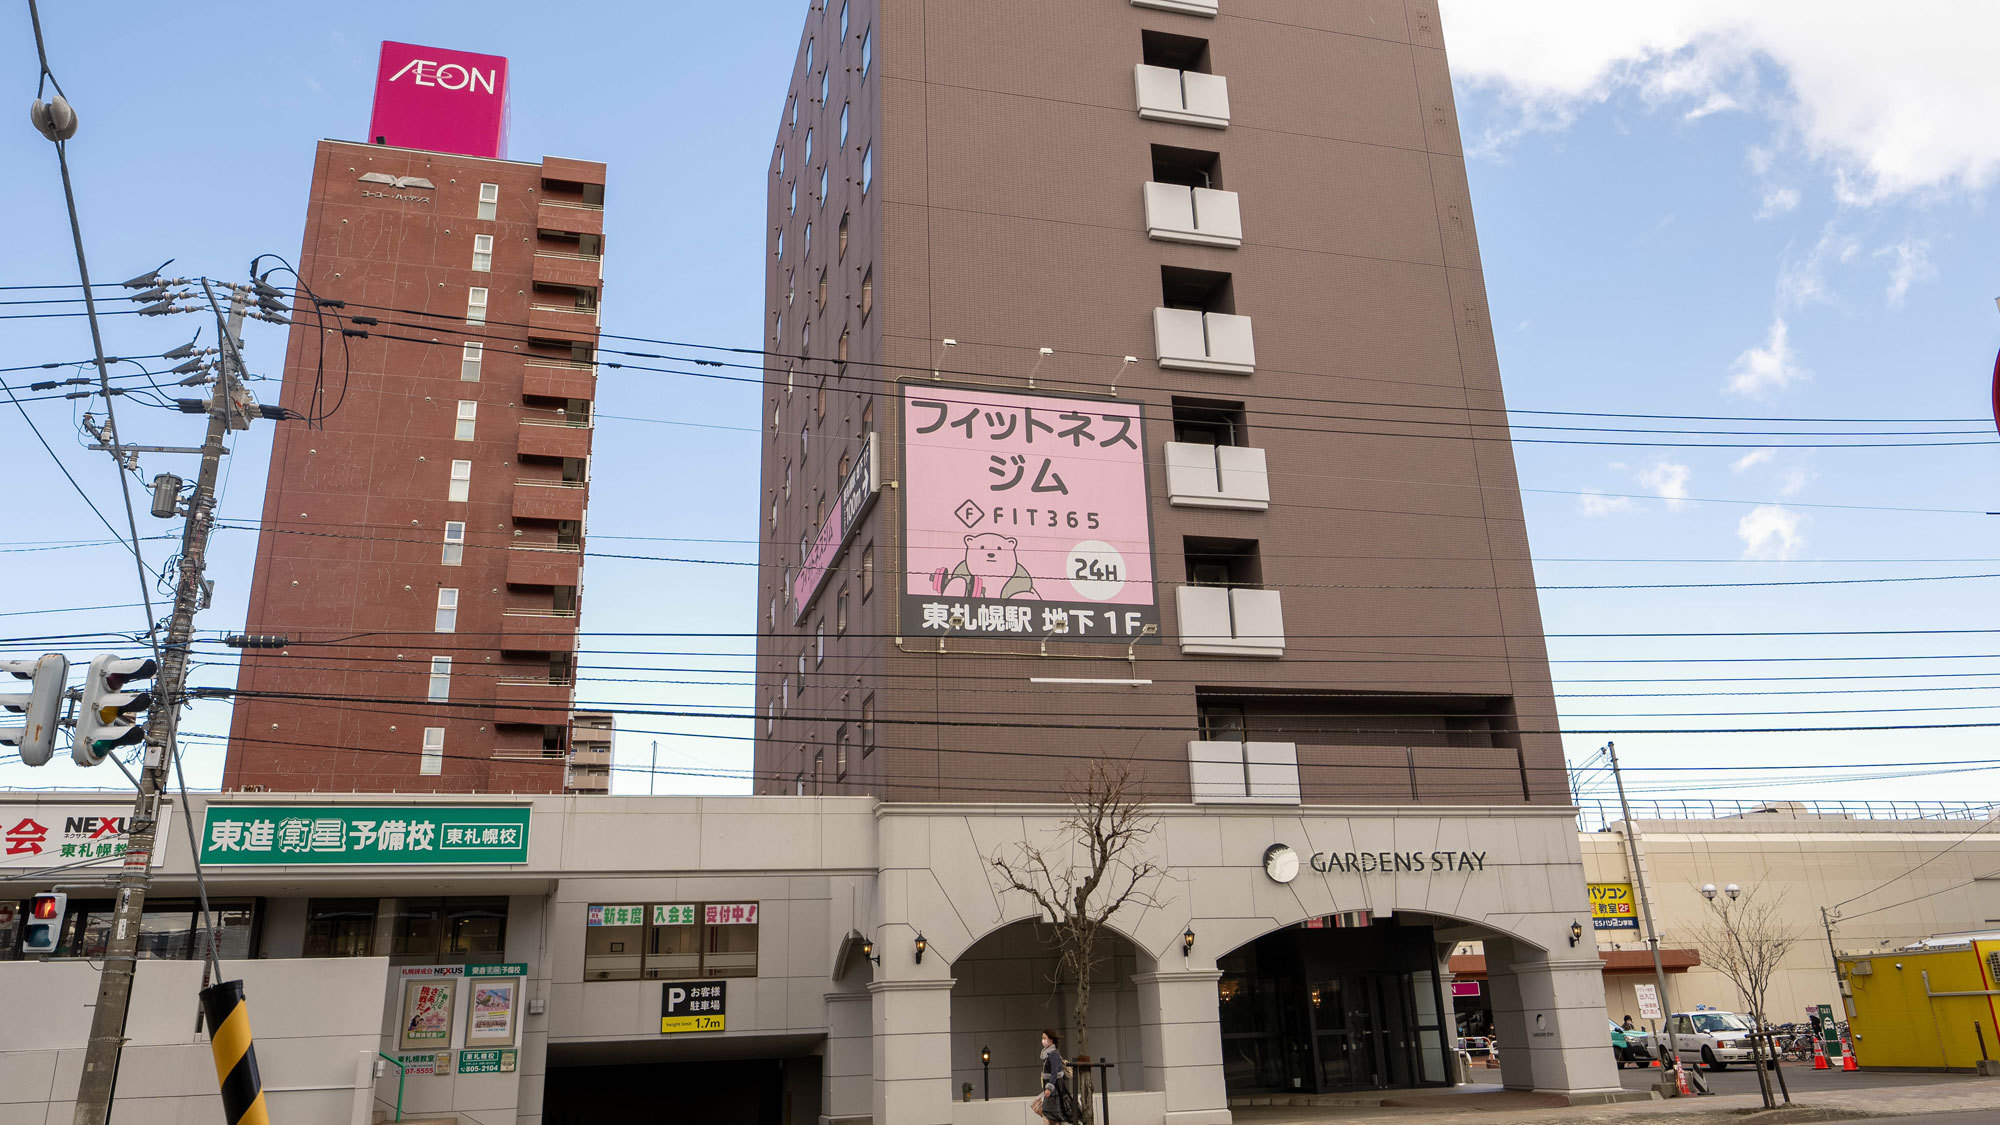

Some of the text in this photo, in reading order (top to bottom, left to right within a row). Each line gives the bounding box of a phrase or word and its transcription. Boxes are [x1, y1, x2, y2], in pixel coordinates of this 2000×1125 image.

[911, 401, 1138, 450] フィットネス
[989, 455, 1068, 495] ジム
[994, 507, 1100, 529] FIT365
[1075, 558, 1118, 581] 24H
[922, 602, 1032, 633] 東札幌駅
[0, 818, 49, 856] 会
[65, 817, 133, 839] NEXU
[208, 818, 517, 852] 東進衛星予備校 東札幌校
[60, 843, 127, 857] 東札幌教
[1310, 851, 1487, 873] GARDENS STAY
[1588, 886, 1627, 899] パソコン
[603, 907, 643, 924] 新年度
[654, 906, 694, 923] 入会生
[1598, 903, 1629, 914] 教室 2F
[434, 967, 463, 976] NEXUS
[668, 987, 686, 1012] P
[690, 986, 721, 998] お客様
[689, 1000, 721, 1012] 駐車場
[695, 1018, 720, 1029] 1.7m
